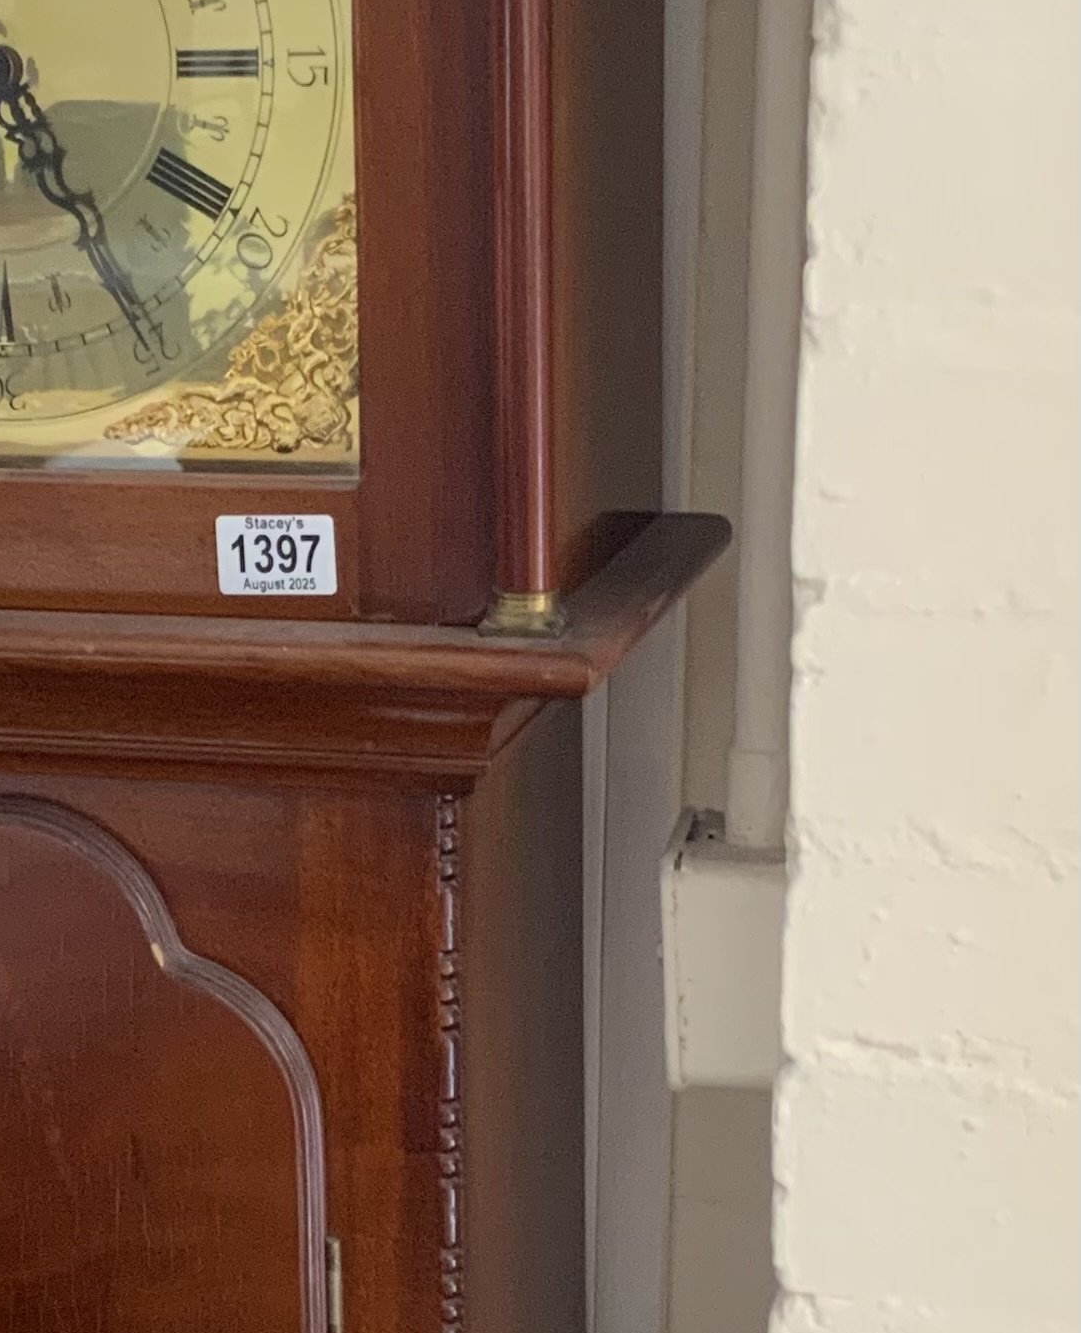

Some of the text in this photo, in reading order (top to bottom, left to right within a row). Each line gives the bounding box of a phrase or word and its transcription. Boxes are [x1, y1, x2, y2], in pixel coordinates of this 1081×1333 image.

[287, 45, 329, 87] 15
[236, 207, 290, 271] 20
[245, 517, 304, 532] Stacey's
[231, 534, 320, 573] 1397
[243, 578, 316, 592] August 2025
